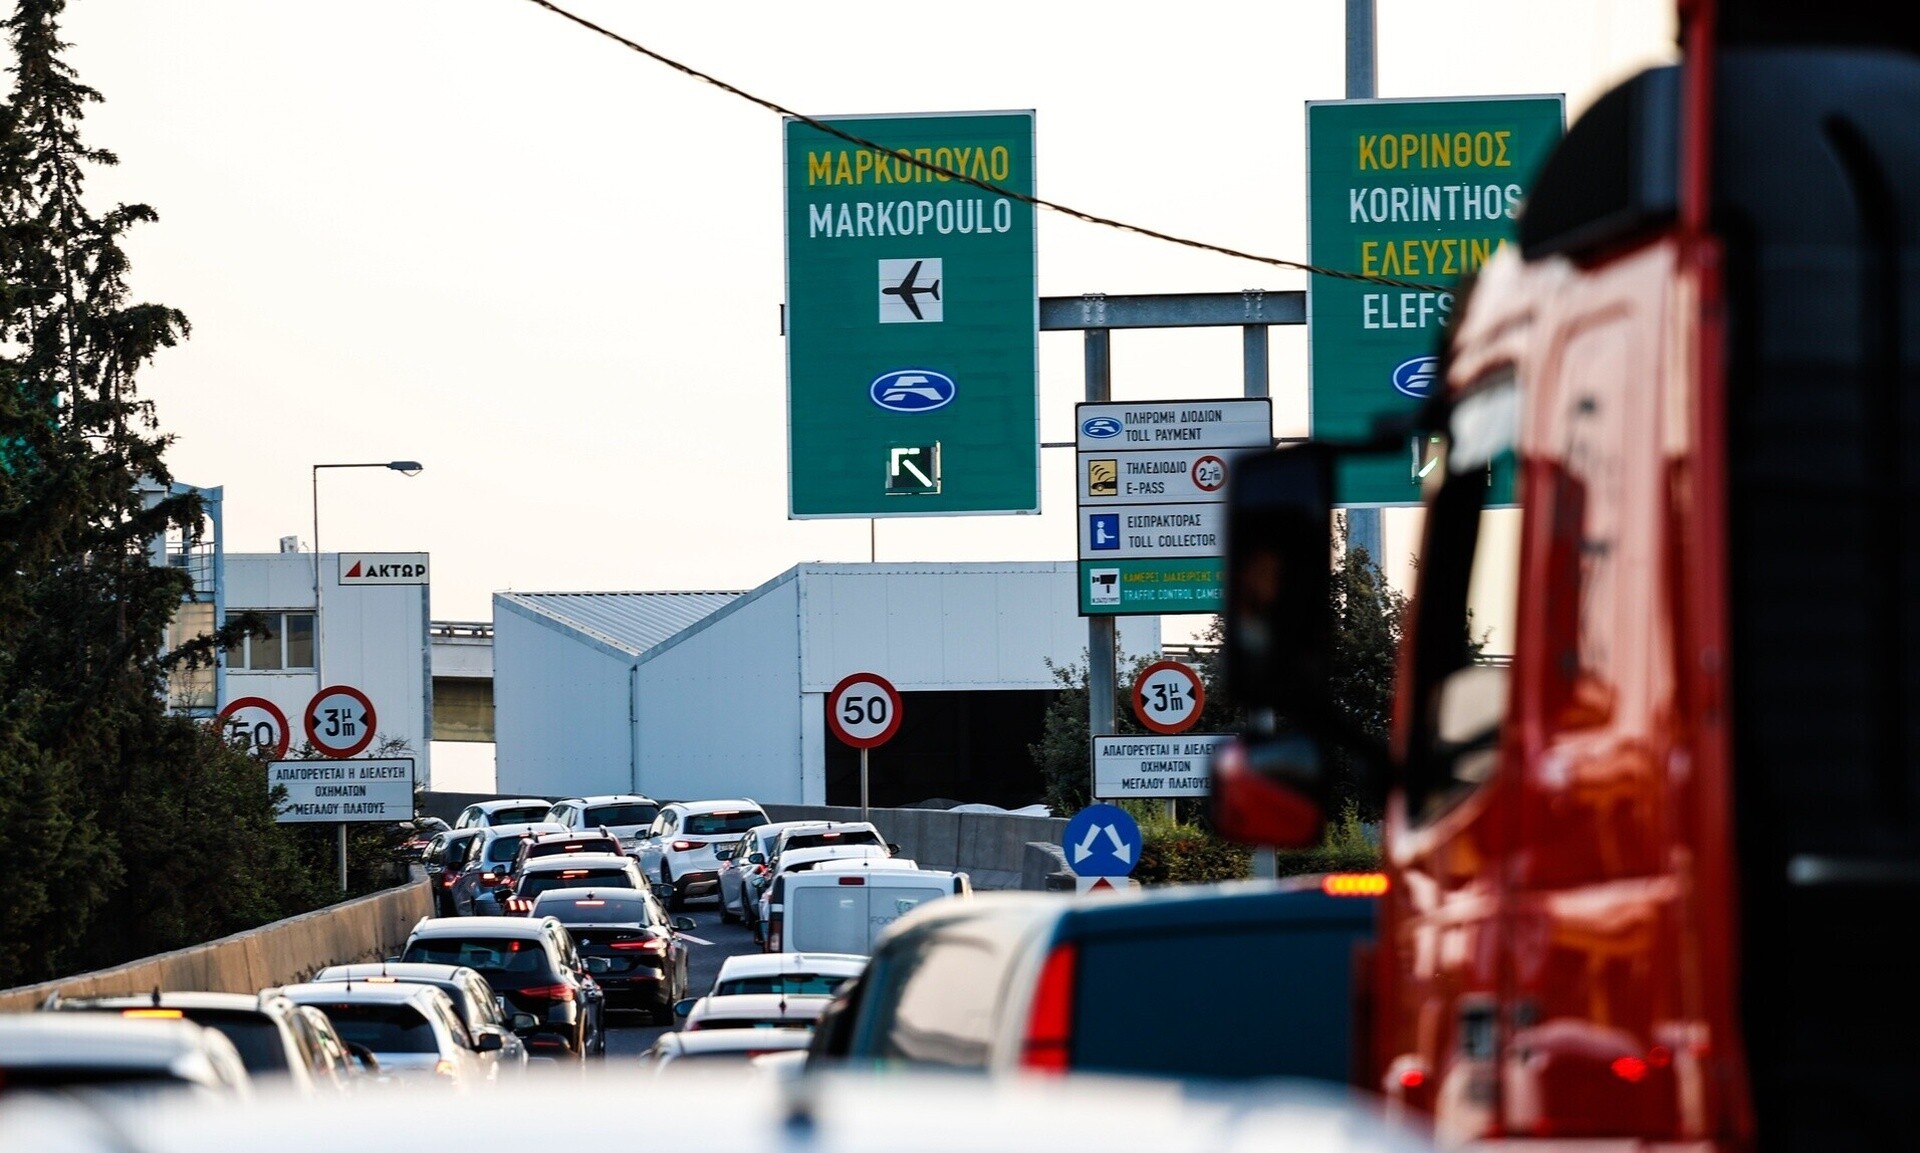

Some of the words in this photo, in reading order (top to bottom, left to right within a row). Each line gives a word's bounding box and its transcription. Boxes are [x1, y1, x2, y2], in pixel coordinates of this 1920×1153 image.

[1358, 130, 1512, 170] ΚΟΡΙΝΘΟΣ
[807, 145, 1010, 186] ΜΑΡΚΟΠΟΥΛΟ
[1349, 183, 1523, 223] KORINTHOS
[808, 197, 1012, 238] MARKOPOULO
[1124, 411, 1176, 425] ΠΛΗΡΩΜΗ
[1180, 409, 1223, 423] ΔΙΟΔΙΩΝ
[1125, 429, 1152, 442] TOLL
[1155, 427, 1202, 441] PAYMENT
[1126, 461, 1187, 475] ΤΗΛΕΔΙΟΔΙΟ
[1126, 482, 1165, 495] E-PASS
[1127, 513, 1202, 528] ΕΙΣΠΡΑΚΤΟΡΑΣ
[1128, 535, 1154, 548] TOLL
[1158, 533, 1217, 548] COLLECTOR
[365, 564, 426, 578] ΑΚΤΩΡ
[1123, 589, 1156, 601] TRAFFIC
[1157, 588, 1194, 600] CONTROL
[1151, 684, 1168, 712] 3
[843, 696, 887, 725] 50
[324, 708, 340, 737] 3
[231, 721, 274, 749] 50
[1102, 743, 1170, 756] ΑΠΑΓΟΡΕΥΕΤΑΙ
[1173, 743, 1180, 755] Η
[276, 767, 345, 780] ΑΠΑΓΟΡΕΥΕΤΑΙ
[349, 767, 355, 779] Η
[359, 766, 406, 779] ΔΙΕΛΕΥΣΗ
[1140, 760, 1191, 773] ΟΧΗΜΑΤΩΝ
[1121, 778, 1165, 790] ΜΕΓΑΛΟΥ
[1168, 776, 1211, 789] ΠΛΑΤΟΥΣ
[314, 785, 367, 798] ΟΧΗΜΑΤΩΝ
[295, 803, 338, 816] ΜΕΓΑΛΟΥ
[342, 802, 386, 815] ΠΛΑΤΟΥΣ
